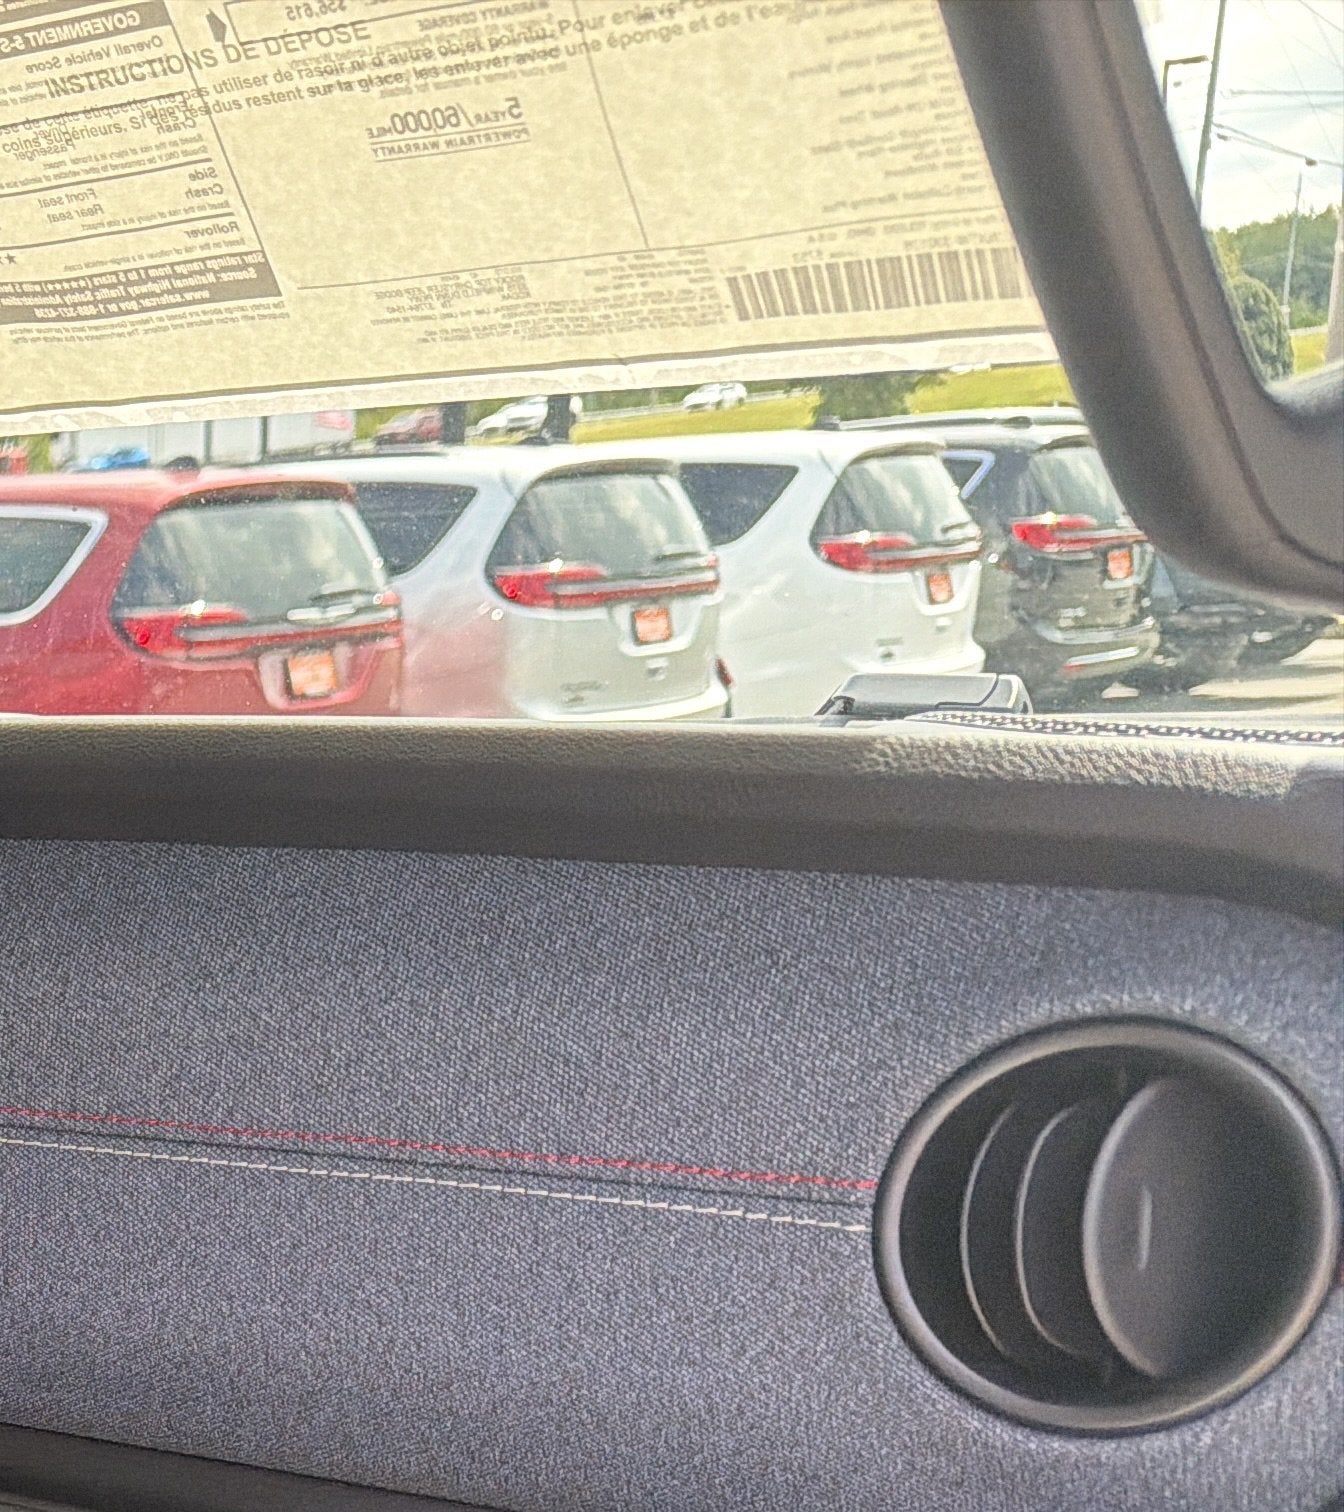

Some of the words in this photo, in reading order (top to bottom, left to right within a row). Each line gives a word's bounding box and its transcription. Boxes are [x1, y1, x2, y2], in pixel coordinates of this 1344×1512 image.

[3, 135, 41, 152] coins
[246, 88, 304, 108] restent
[308, 84, 334, 98] sur
[565, 39, 601, 57] une
[608, 23, 684, 50] éponge
[689, 15, 709, 33] et
[46, 48, 218, 98] INSTRUCTIONS
[225, 44, 260, 64] DE
[264, 22, 372, 57] DÉPOSE
[213, 75, 268, 96] utiliser
[273, 70, 293, 84] de
[298, 62, 345, 80] rasoir
[558, 15, 605, 35] Pour
